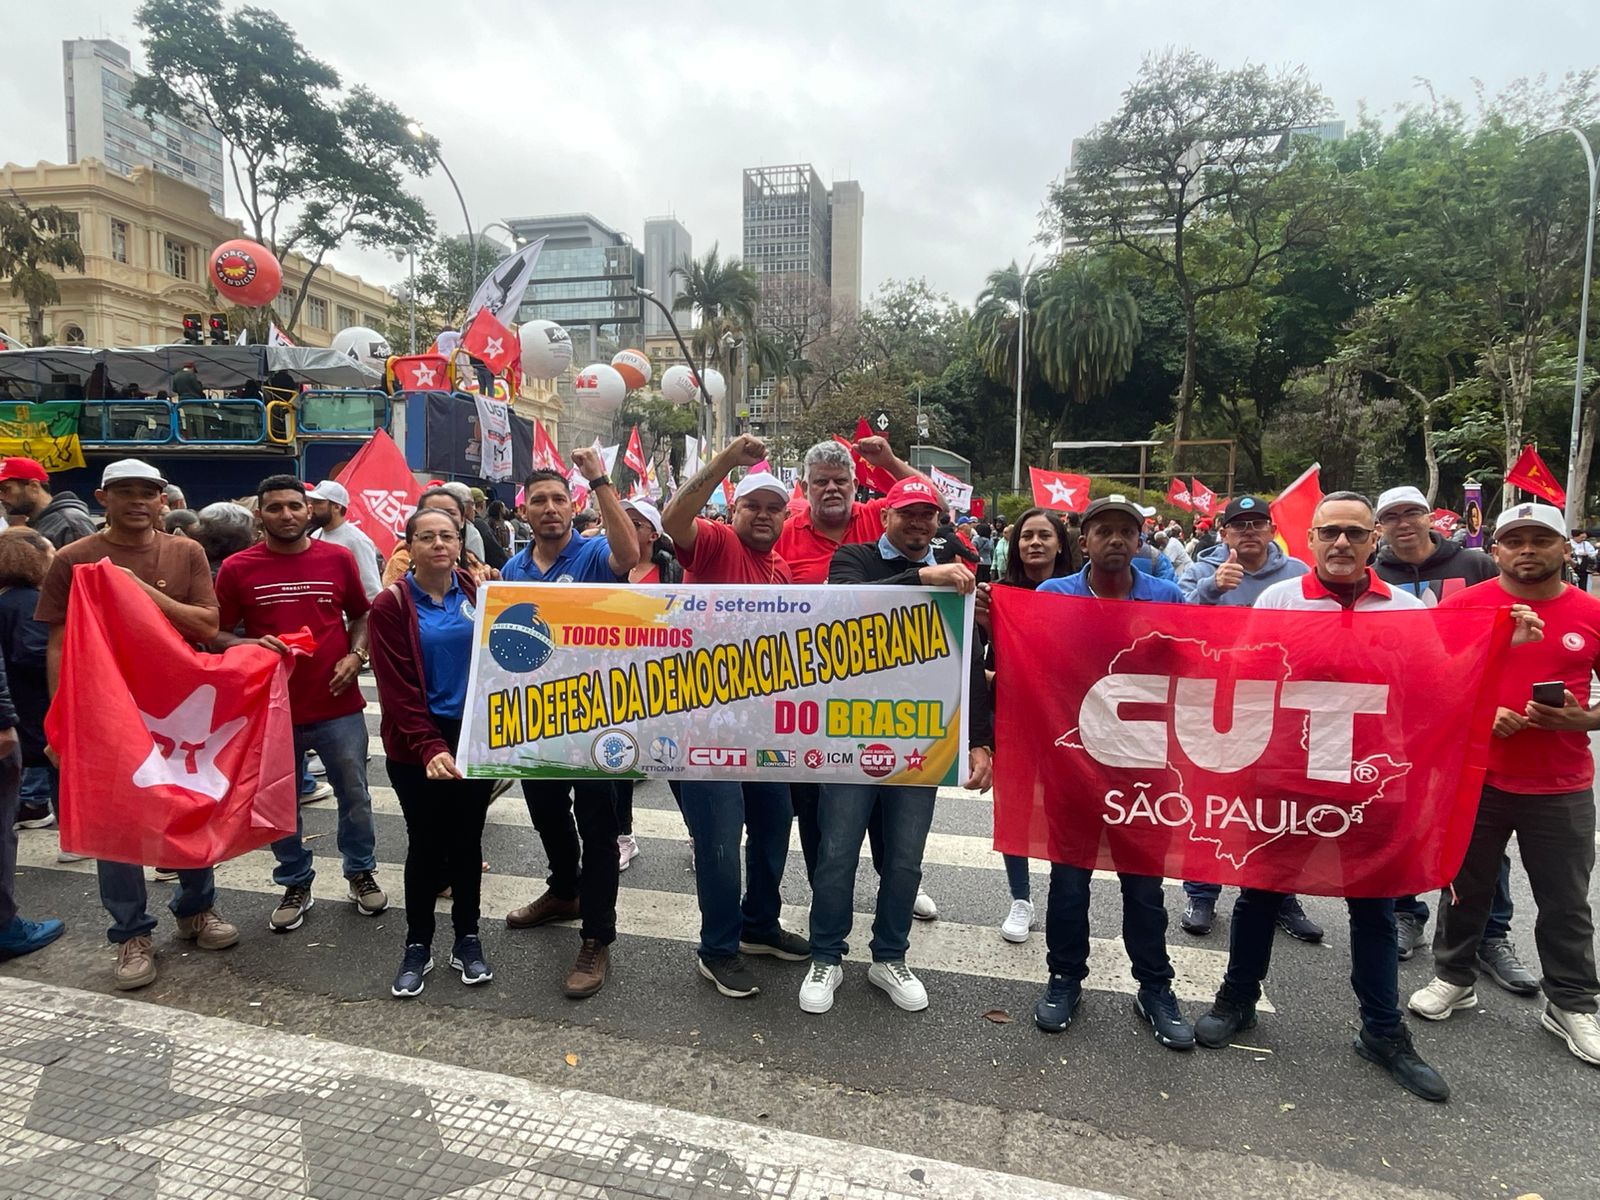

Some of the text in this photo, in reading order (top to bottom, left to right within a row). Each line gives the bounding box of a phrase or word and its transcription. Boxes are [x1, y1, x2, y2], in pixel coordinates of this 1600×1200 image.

[218, 268, 256, 287] SINDICAL
[420, 371, 431, 380] PT
[903, 482, 931, 494] CUT
[665, 594, 812, 613] 7 de setembro
[562, 626, 694, 648] TODOS UNIDOS
[488, 600, 951, 749] EM DEFESA DA DEMOCRACIA E SOBERANIA
[774, 699, 945, 739] DO BRASIL
[1078, 673, 1390, 784] CUT
[690, 748, 746, 766] CUT
[827, 752, 854, 764] ICM
[861, 754, 895, 766] CUT
[910, 757, 922, 765] PT
[1102, 782, 1352, 839] SÃO PAULO
